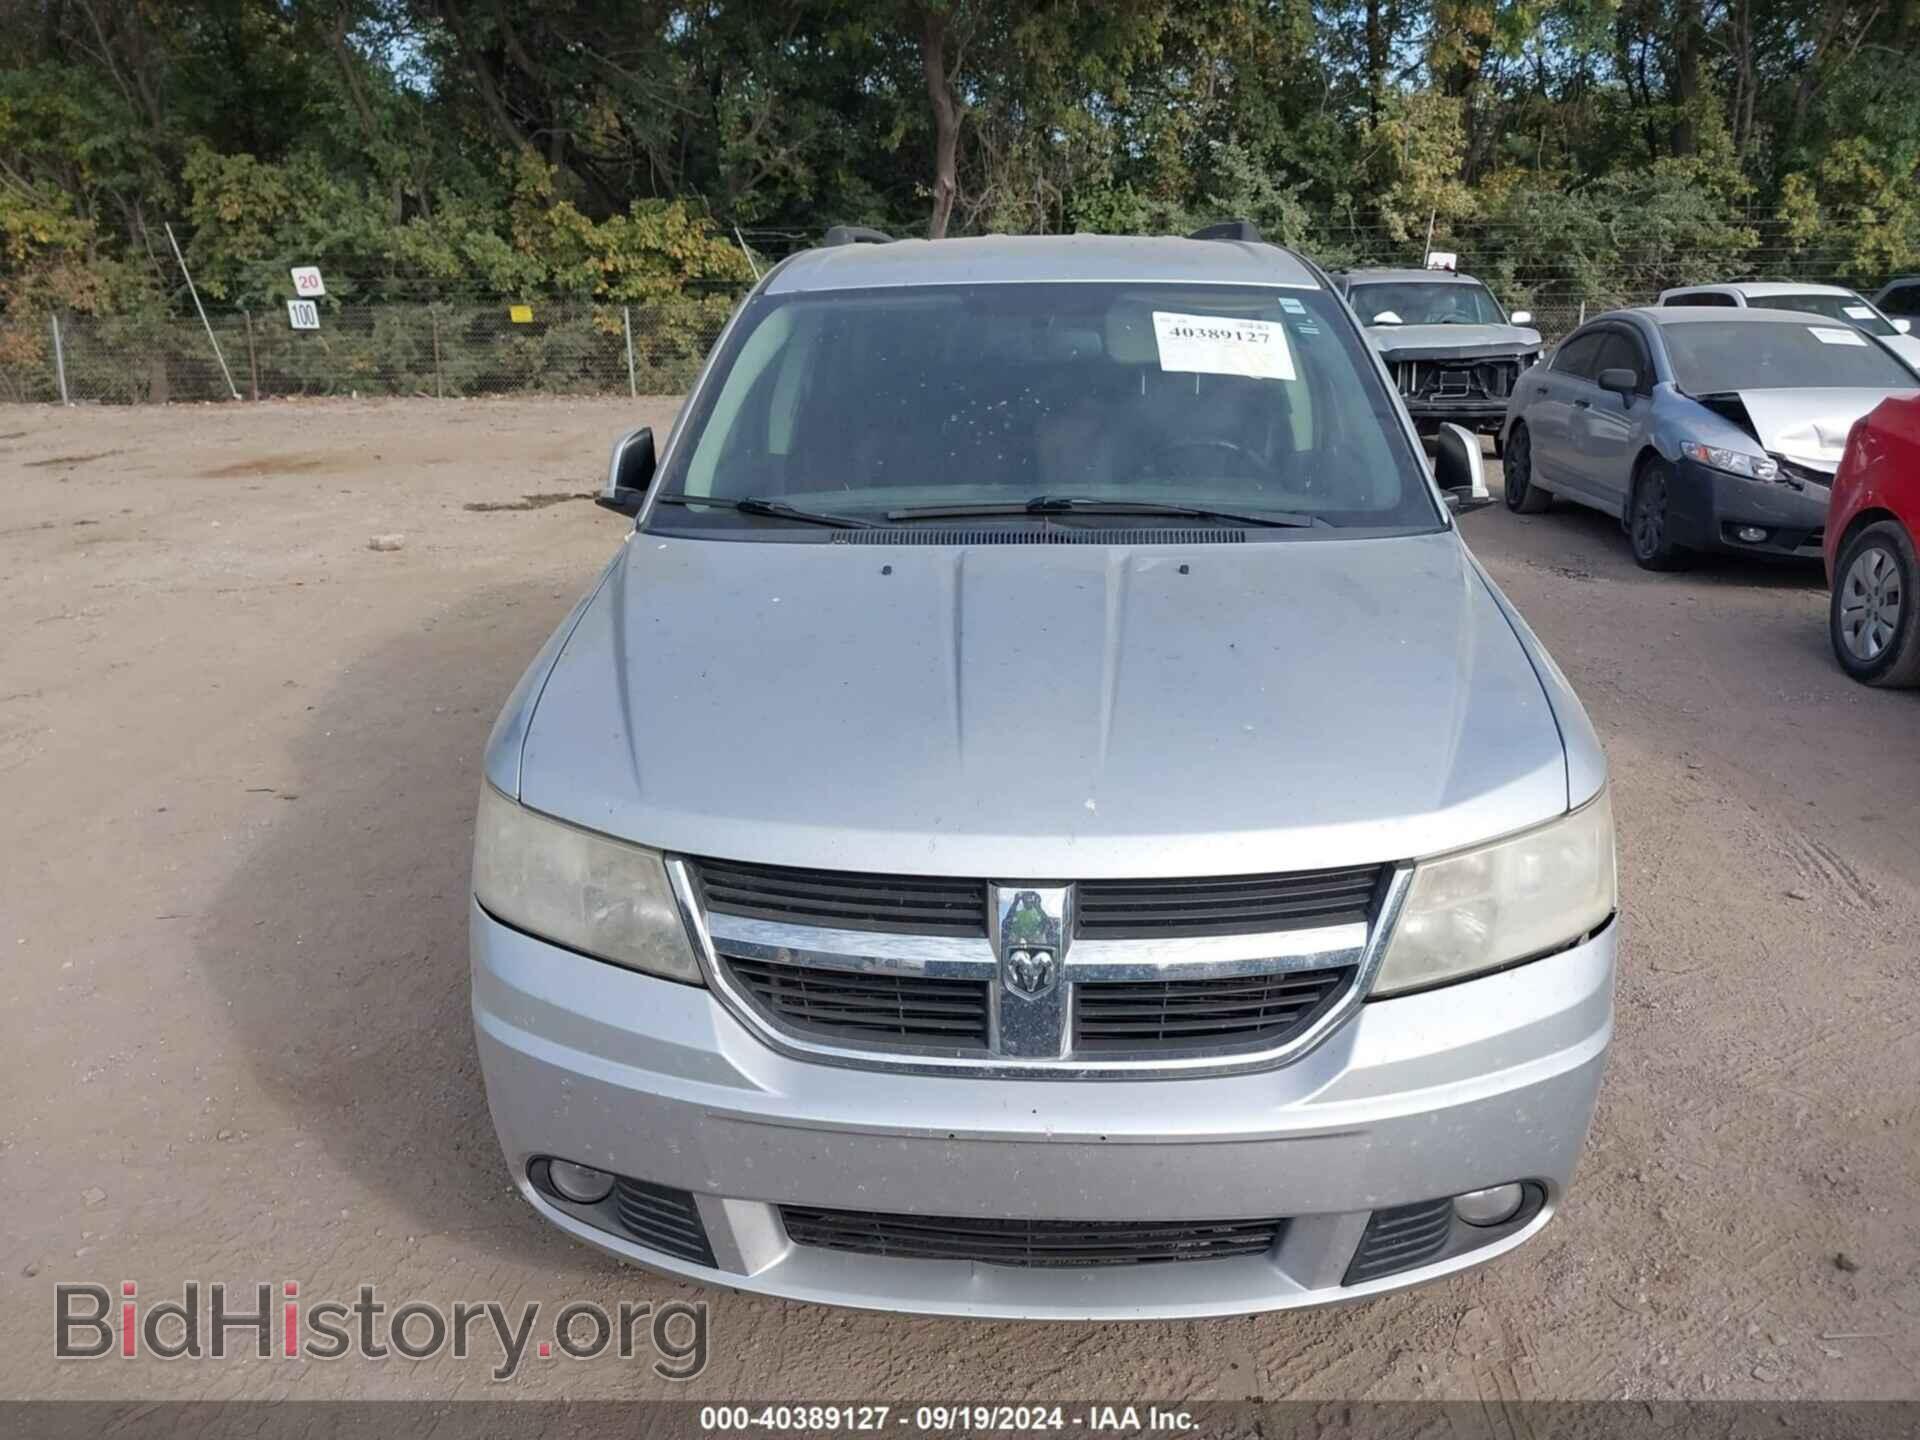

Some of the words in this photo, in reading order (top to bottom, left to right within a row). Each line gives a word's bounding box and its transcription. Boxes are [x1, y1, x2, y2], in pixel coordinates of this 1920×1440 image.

[299, 275, 318, 288] 20
[292, 304, 315, 325] 100
[1169, 327, 1270, 343] 40389127
